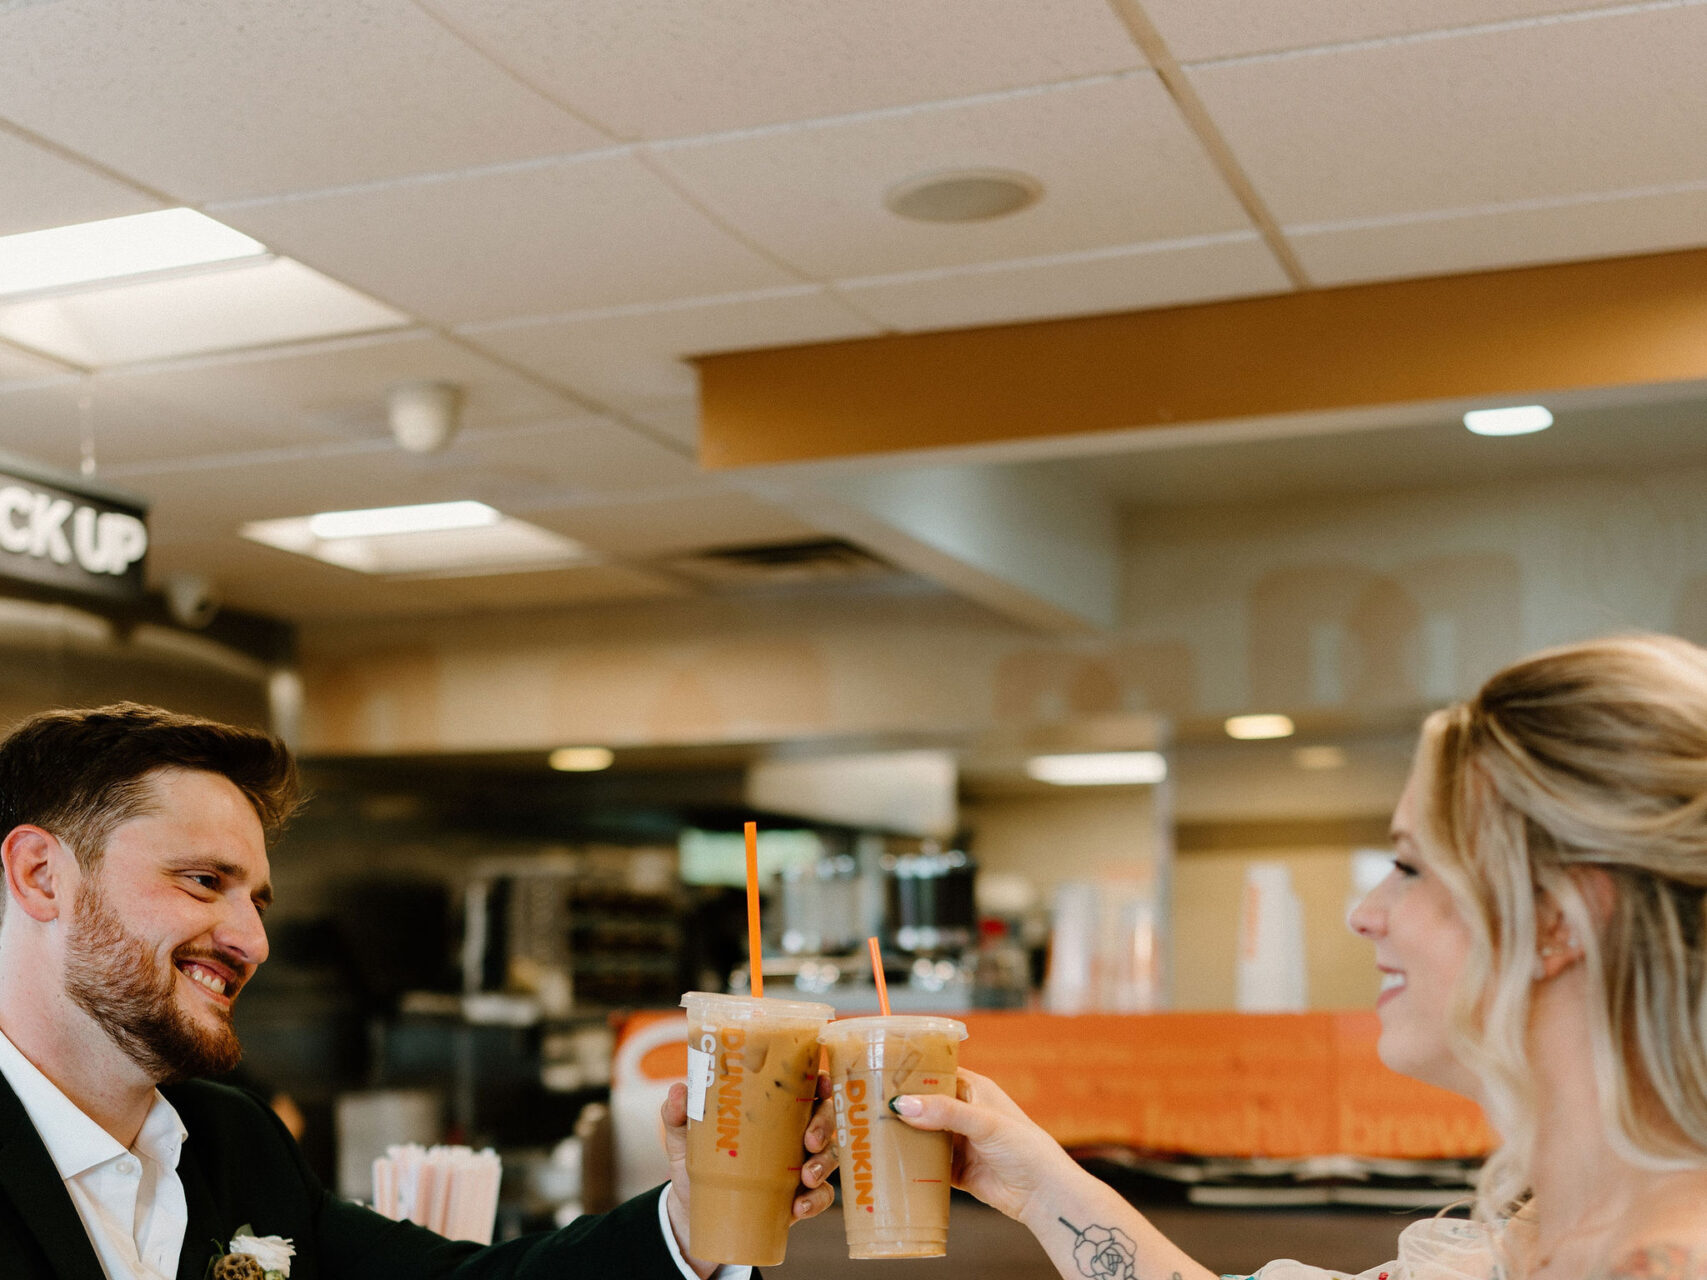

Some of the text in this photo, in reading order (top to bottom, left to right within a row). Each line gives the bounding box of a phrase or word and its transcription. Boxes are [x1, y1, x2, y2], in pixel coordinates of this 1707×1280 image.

[74, 506, 148, 576] UP
[716, 1027, 746, 1158] DUNKIN'
[833, 1083, 847, 1148] ICED
[846, 1079, 875, 1213] DUNKIN'
